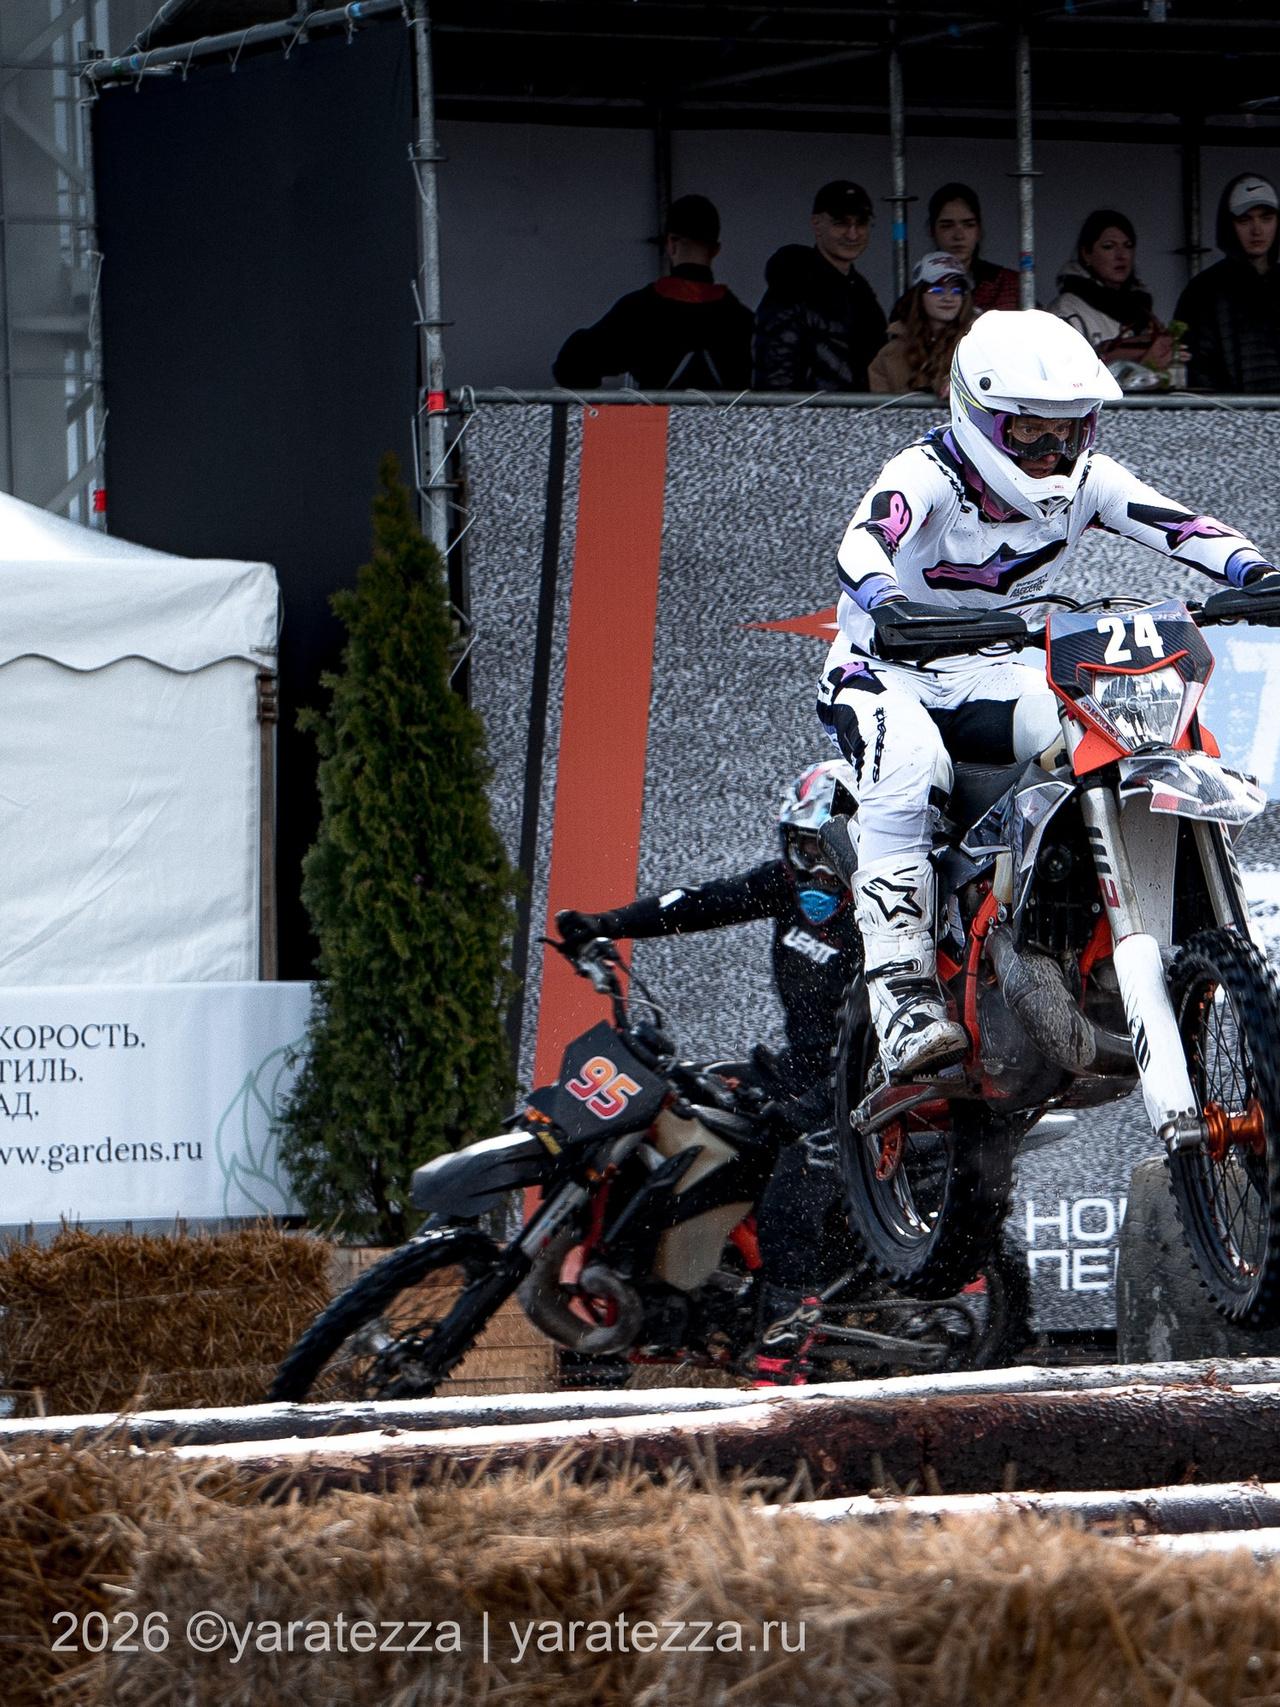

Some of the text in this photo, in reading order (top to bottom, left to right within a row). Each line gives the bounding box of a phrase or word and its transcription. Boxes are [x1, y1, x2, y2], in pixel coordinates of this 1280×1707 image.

[1096, 613, 1165, 665] 24
[565, 1056, 643, 1119] 95
[1027, 1247, 1119, 1290] ПЕ
